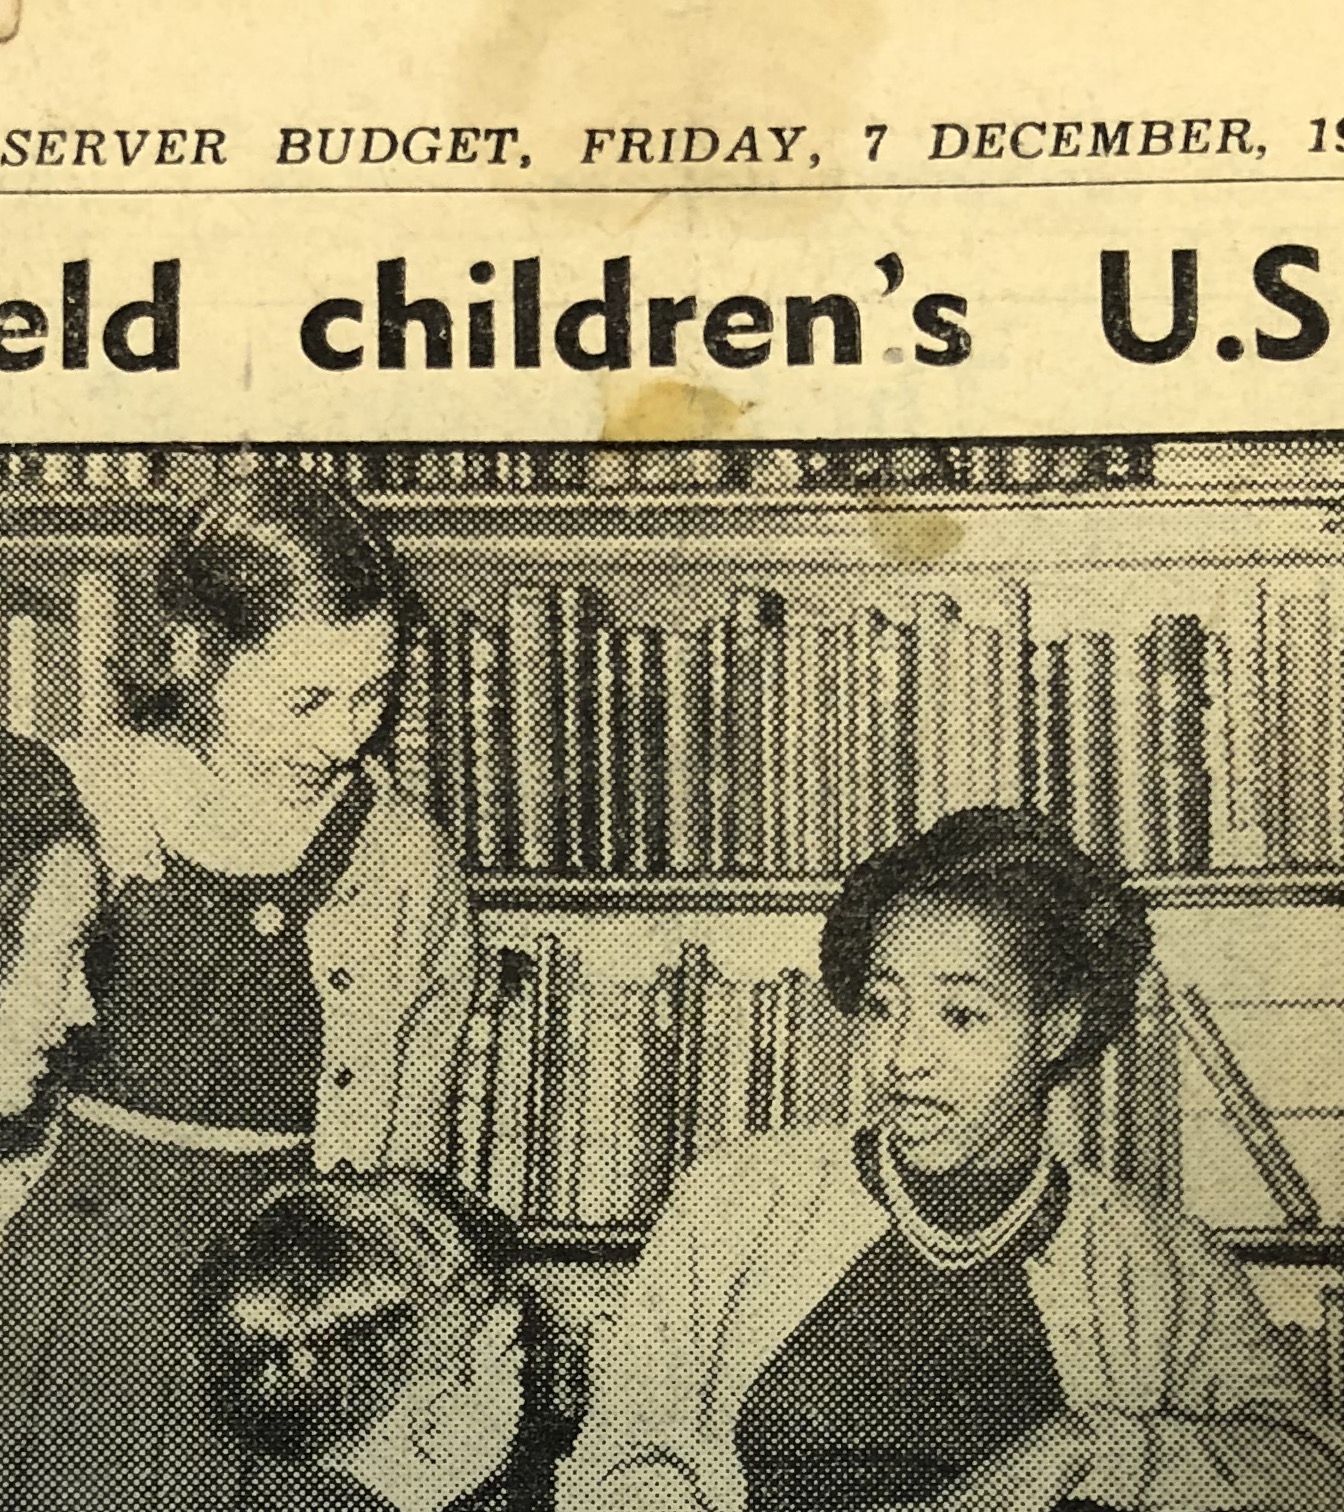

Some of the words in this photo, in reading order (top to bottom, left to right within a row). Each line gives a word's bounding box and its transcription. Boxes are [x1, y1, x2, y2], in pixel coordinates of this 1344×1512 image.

[276, 126, 532, 169] BUDGET,
[580, 125, 821, 170] FRIDAY,
[864, 123, 889, 162] 7
[927, 118, 1267, 161] DECEMBER,
[299, 251, 972, 372] children's
[1099, 243, 1331, 365] U.S
